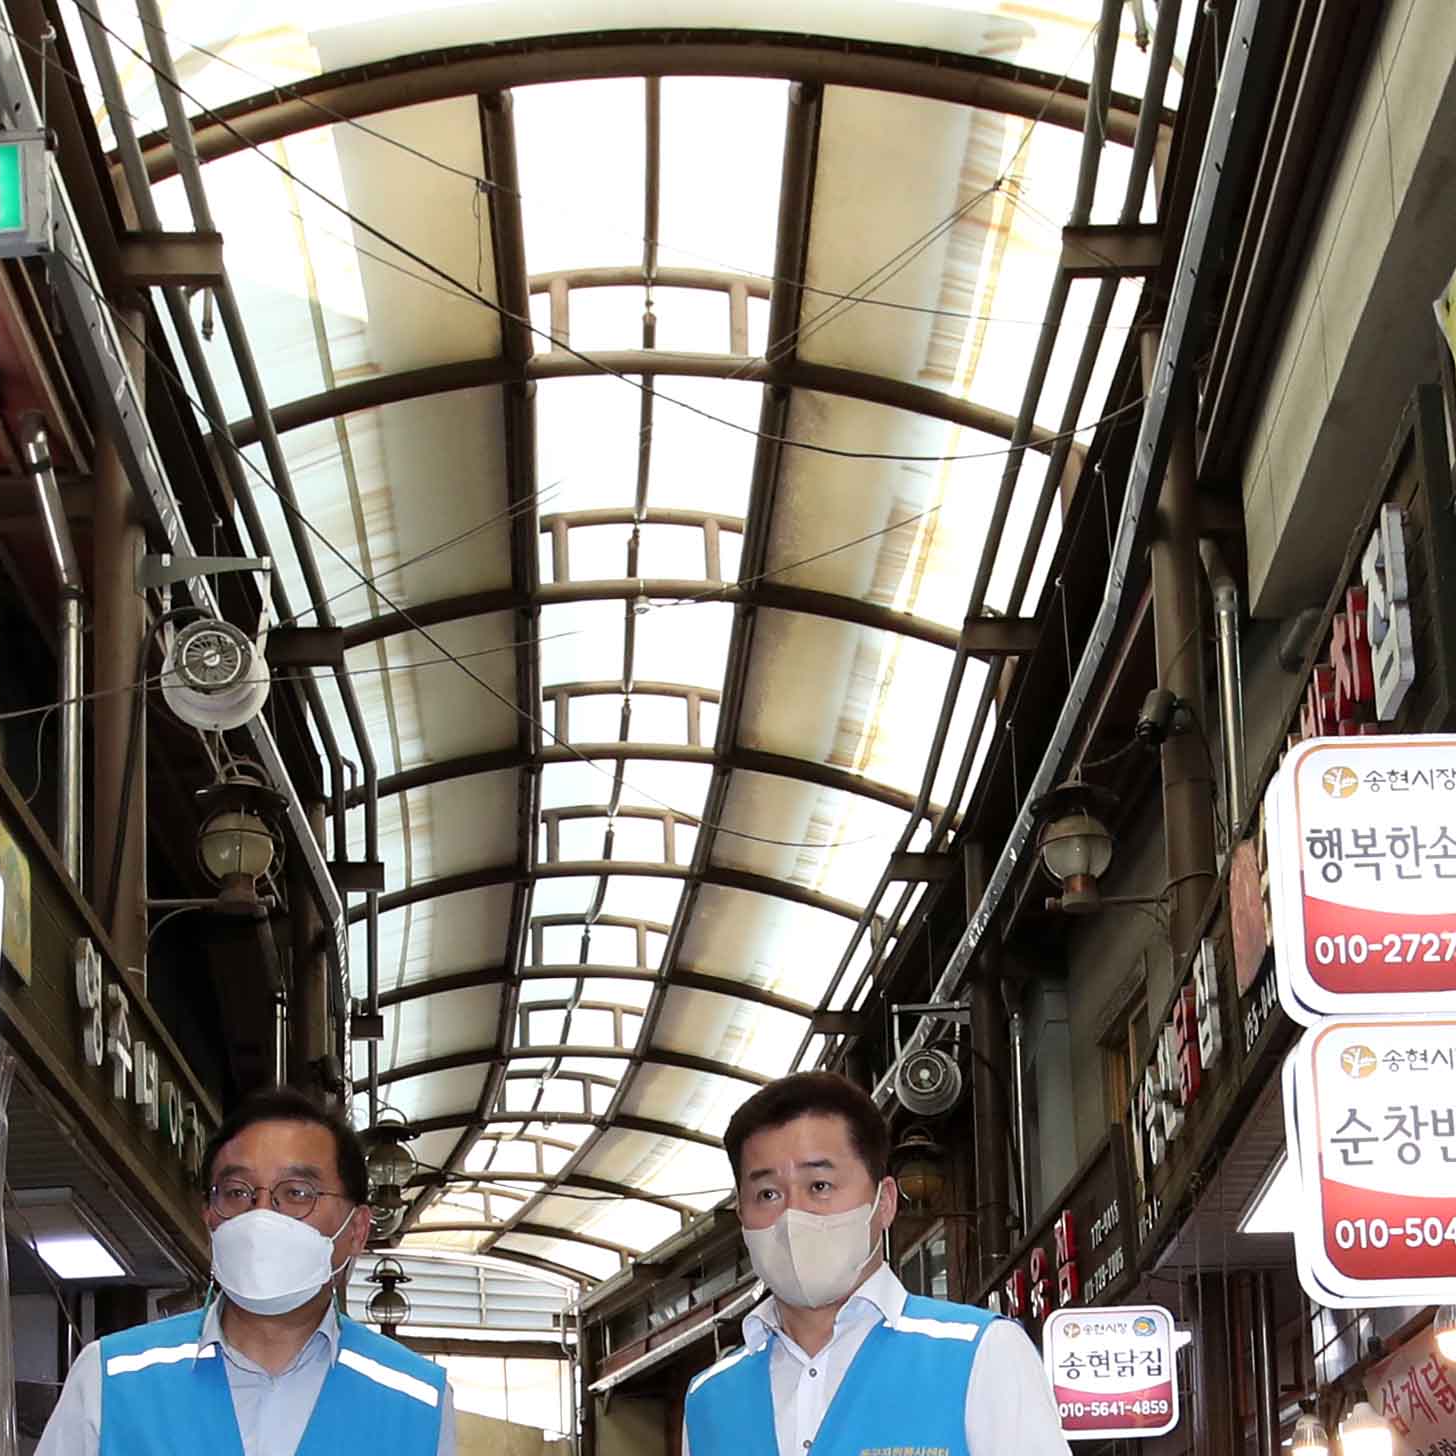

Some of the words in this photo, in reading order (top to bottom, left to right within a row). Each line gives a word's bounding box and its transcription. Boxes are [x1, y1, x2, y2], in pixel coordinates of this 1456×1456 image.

[1083, 1322, 1128, 1336] 송현시장
[1058, 1346, 1163, 1380] 송현닭집
[1059, 1399, 1168, 1418] 010-5641-4859
